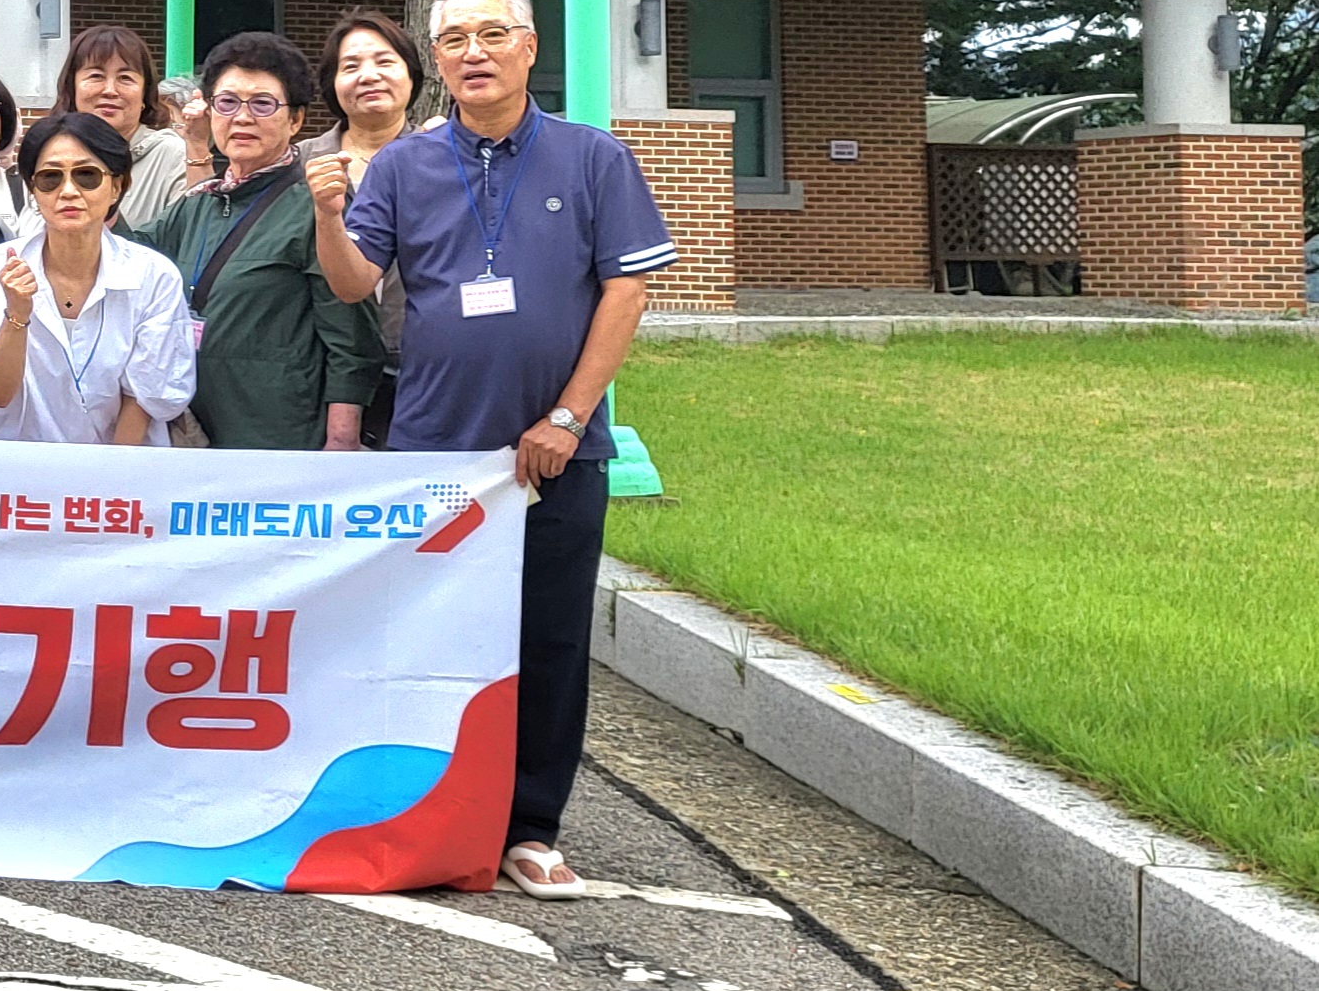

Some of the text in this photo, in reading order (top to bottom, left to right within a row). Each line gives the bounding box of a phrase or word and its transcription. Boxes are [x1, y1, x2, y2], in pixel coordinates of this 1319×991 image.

[64, 496, 154, 539] 변화,
[169, 501, 333, 539] 미래도시
[344, 504, 425, 539] 오산
